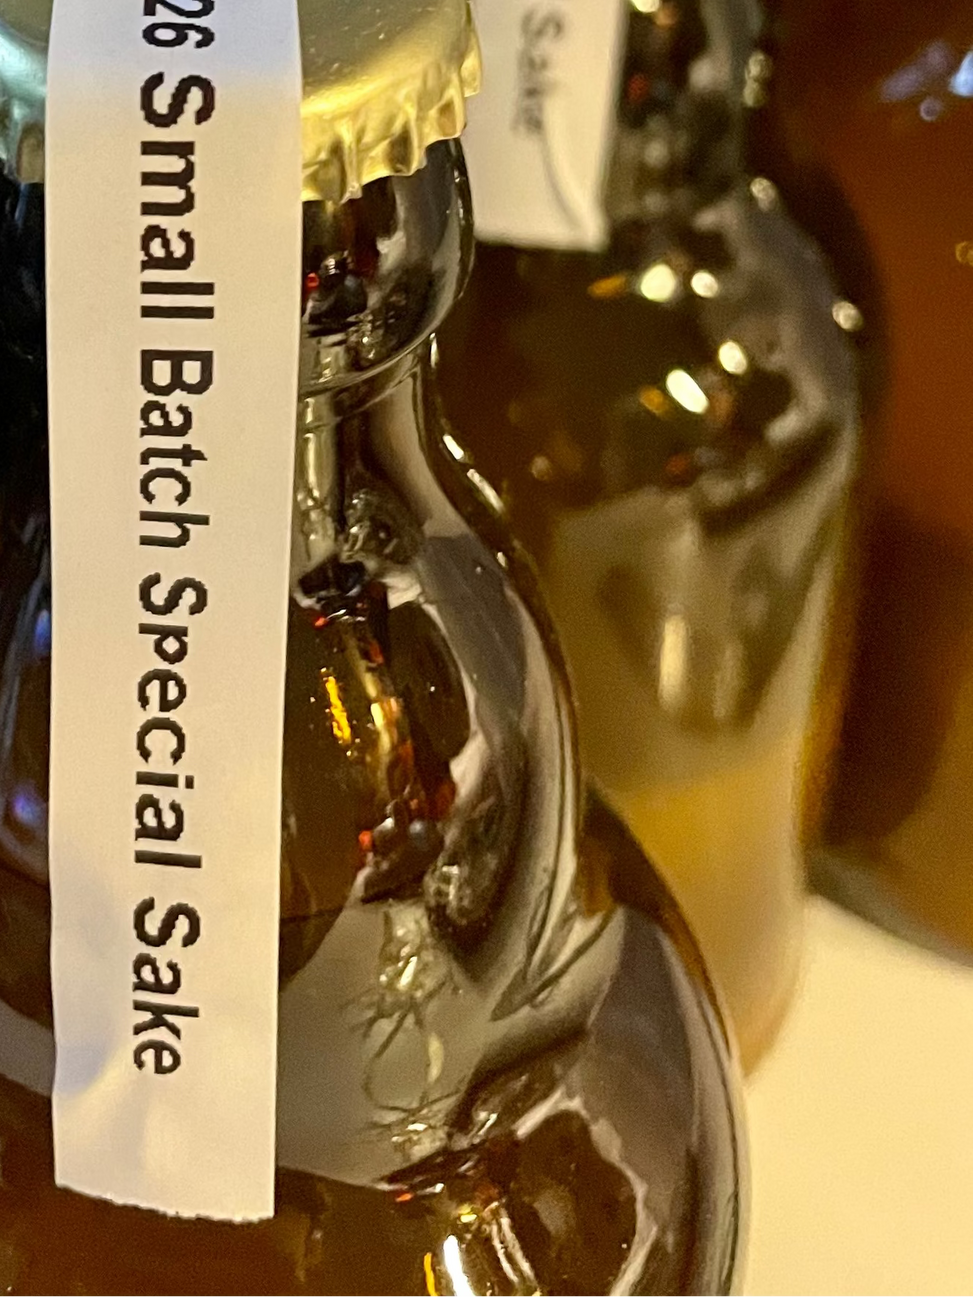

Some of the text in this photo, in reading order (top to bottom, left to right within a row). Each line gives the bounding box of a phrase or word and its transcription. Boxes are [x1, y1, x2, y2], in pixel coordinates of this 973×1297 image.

[140, 71, 216, 320] Small
[139, 349, 214, 549] Batch
[134, 572, 208, 869] Special
[132, 897, 201, 1076] Sake
